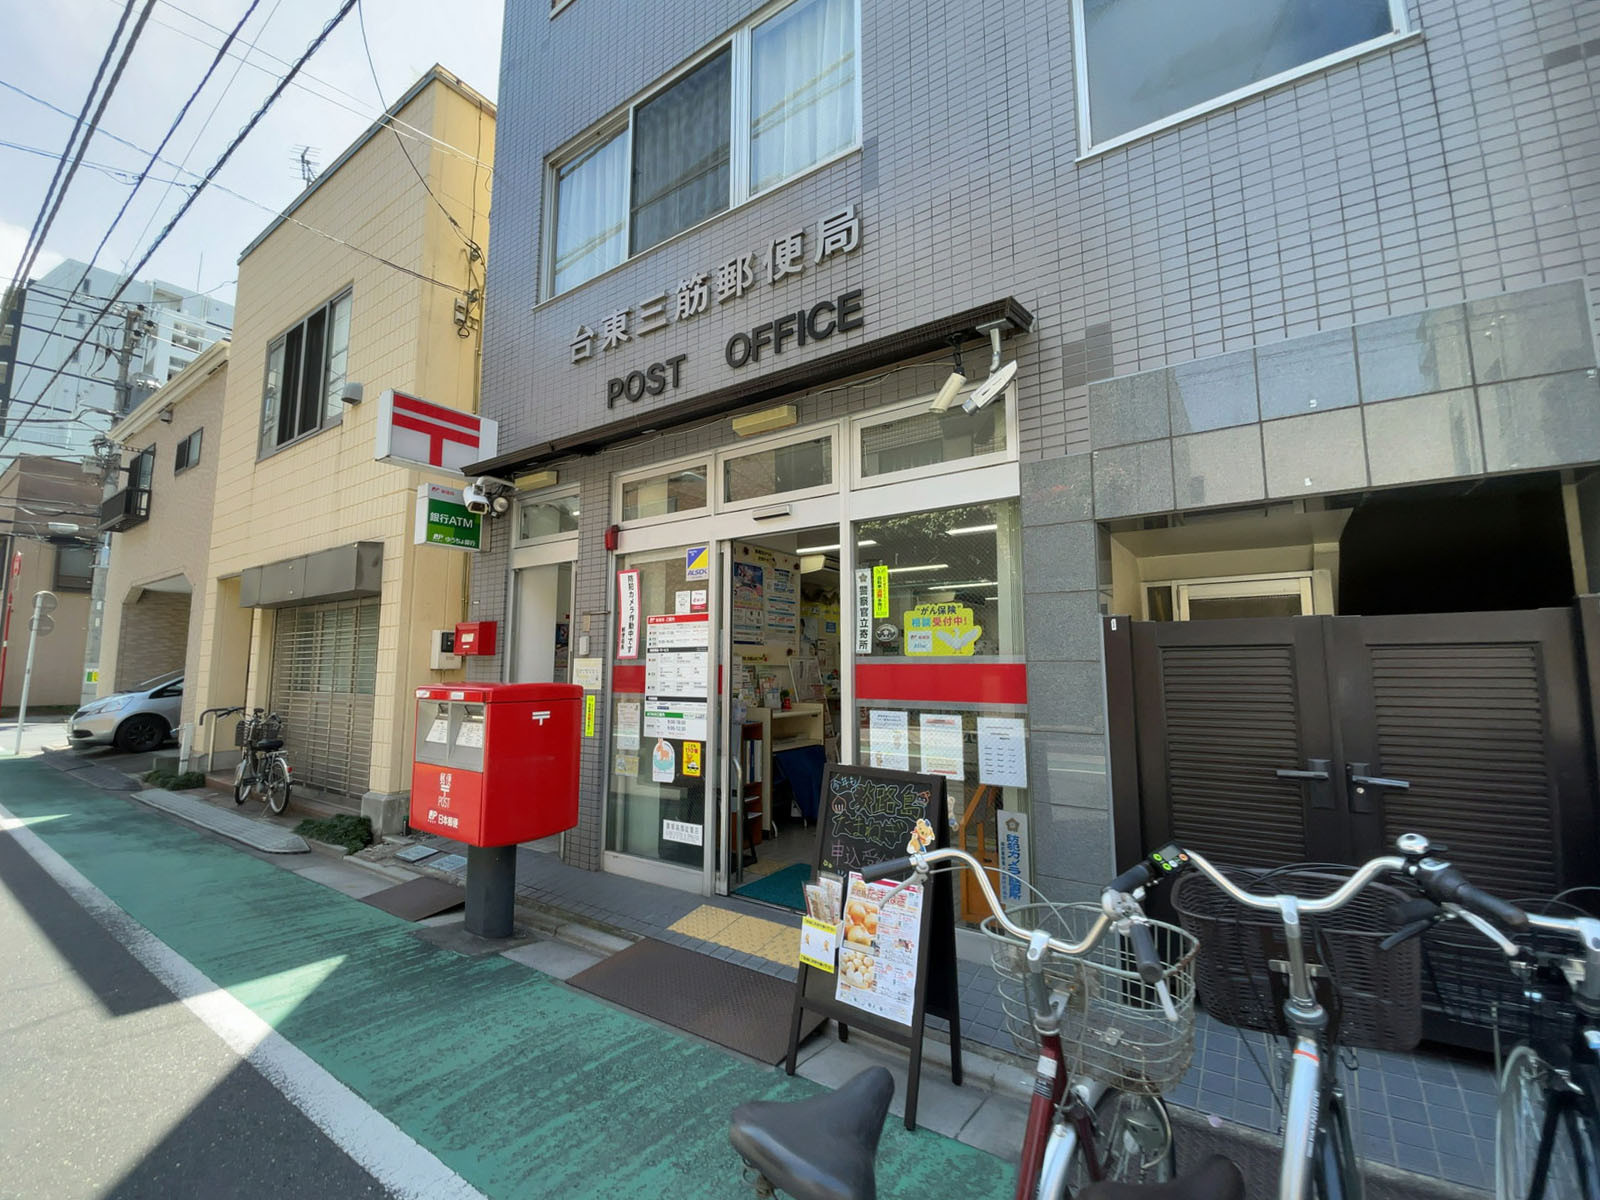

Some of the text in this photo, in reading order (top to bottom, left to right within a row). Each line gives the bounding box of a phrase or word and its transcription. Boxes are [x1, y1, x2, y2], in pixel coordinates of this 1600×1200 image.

[569, 203, 864, 364] 台東三筋郵便局
[606, 288, 865, 409] POST OFFICE
[430, 511, 474, 529] 銀行ATM
[859, 585, 868, 650] 警察官立寄所
[855, 783, 921, 820] 淡路島
[834, 815, 905, 846] たまねぎ
